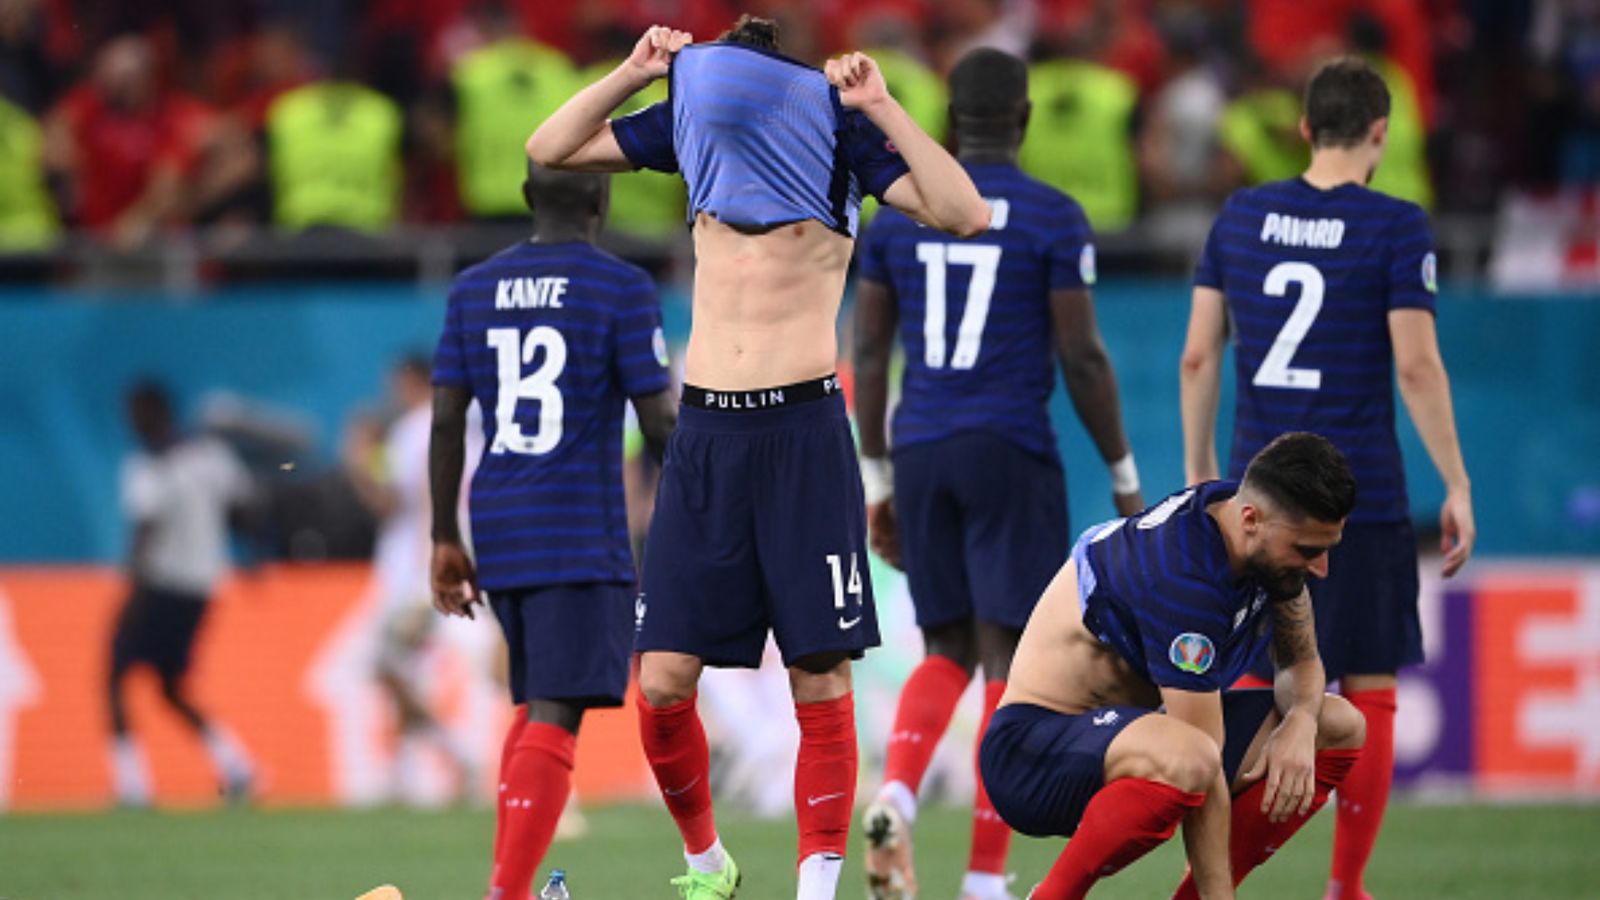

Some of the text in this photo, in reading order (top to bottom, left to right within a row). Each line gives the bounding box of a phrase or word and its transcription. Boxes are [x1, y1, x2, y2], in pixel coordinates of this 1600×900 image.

[1260, 212, 1345, 249] PAVARD
[916, 242, 1002, 370] 17
[1253, 261, 1326, 389] 2
[486, 325, 567, 455] 13
[705, 390, 785, 408] PULLIN
[826, 552, 863, 608] 14
